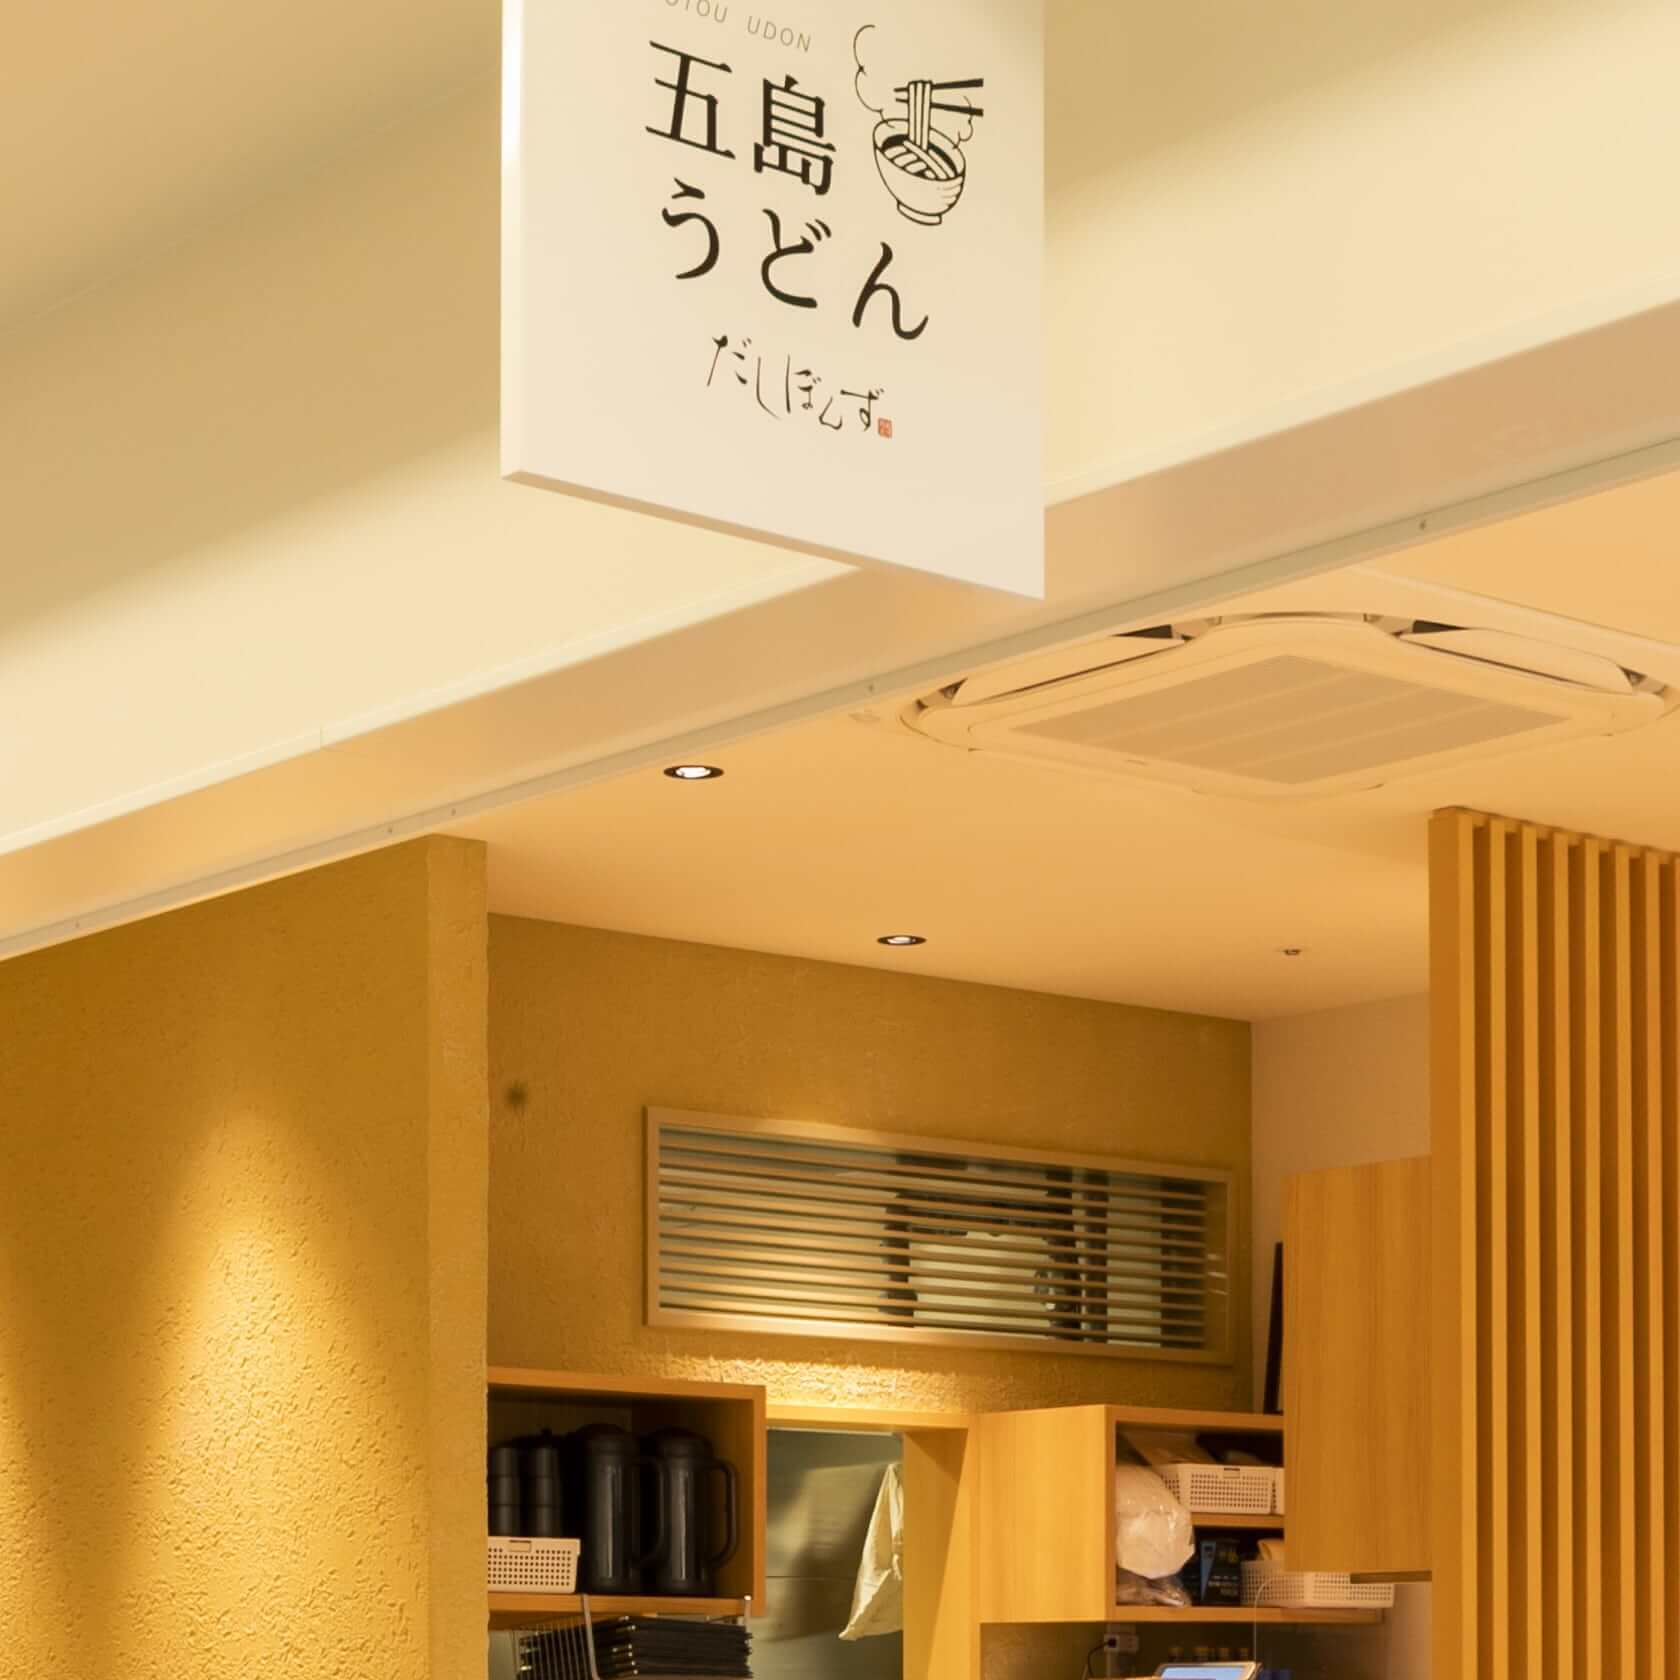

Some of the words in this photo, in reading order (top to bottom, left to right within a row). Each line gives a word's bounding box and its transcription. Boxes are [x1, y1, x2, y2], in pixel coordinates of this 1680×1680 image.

[747, 15, 811, 52] UDON
[645, 40, 836, 196] 五島
[662, 177, 929, 340] うどん
[707, 334, 886, 432] だしぼんず
